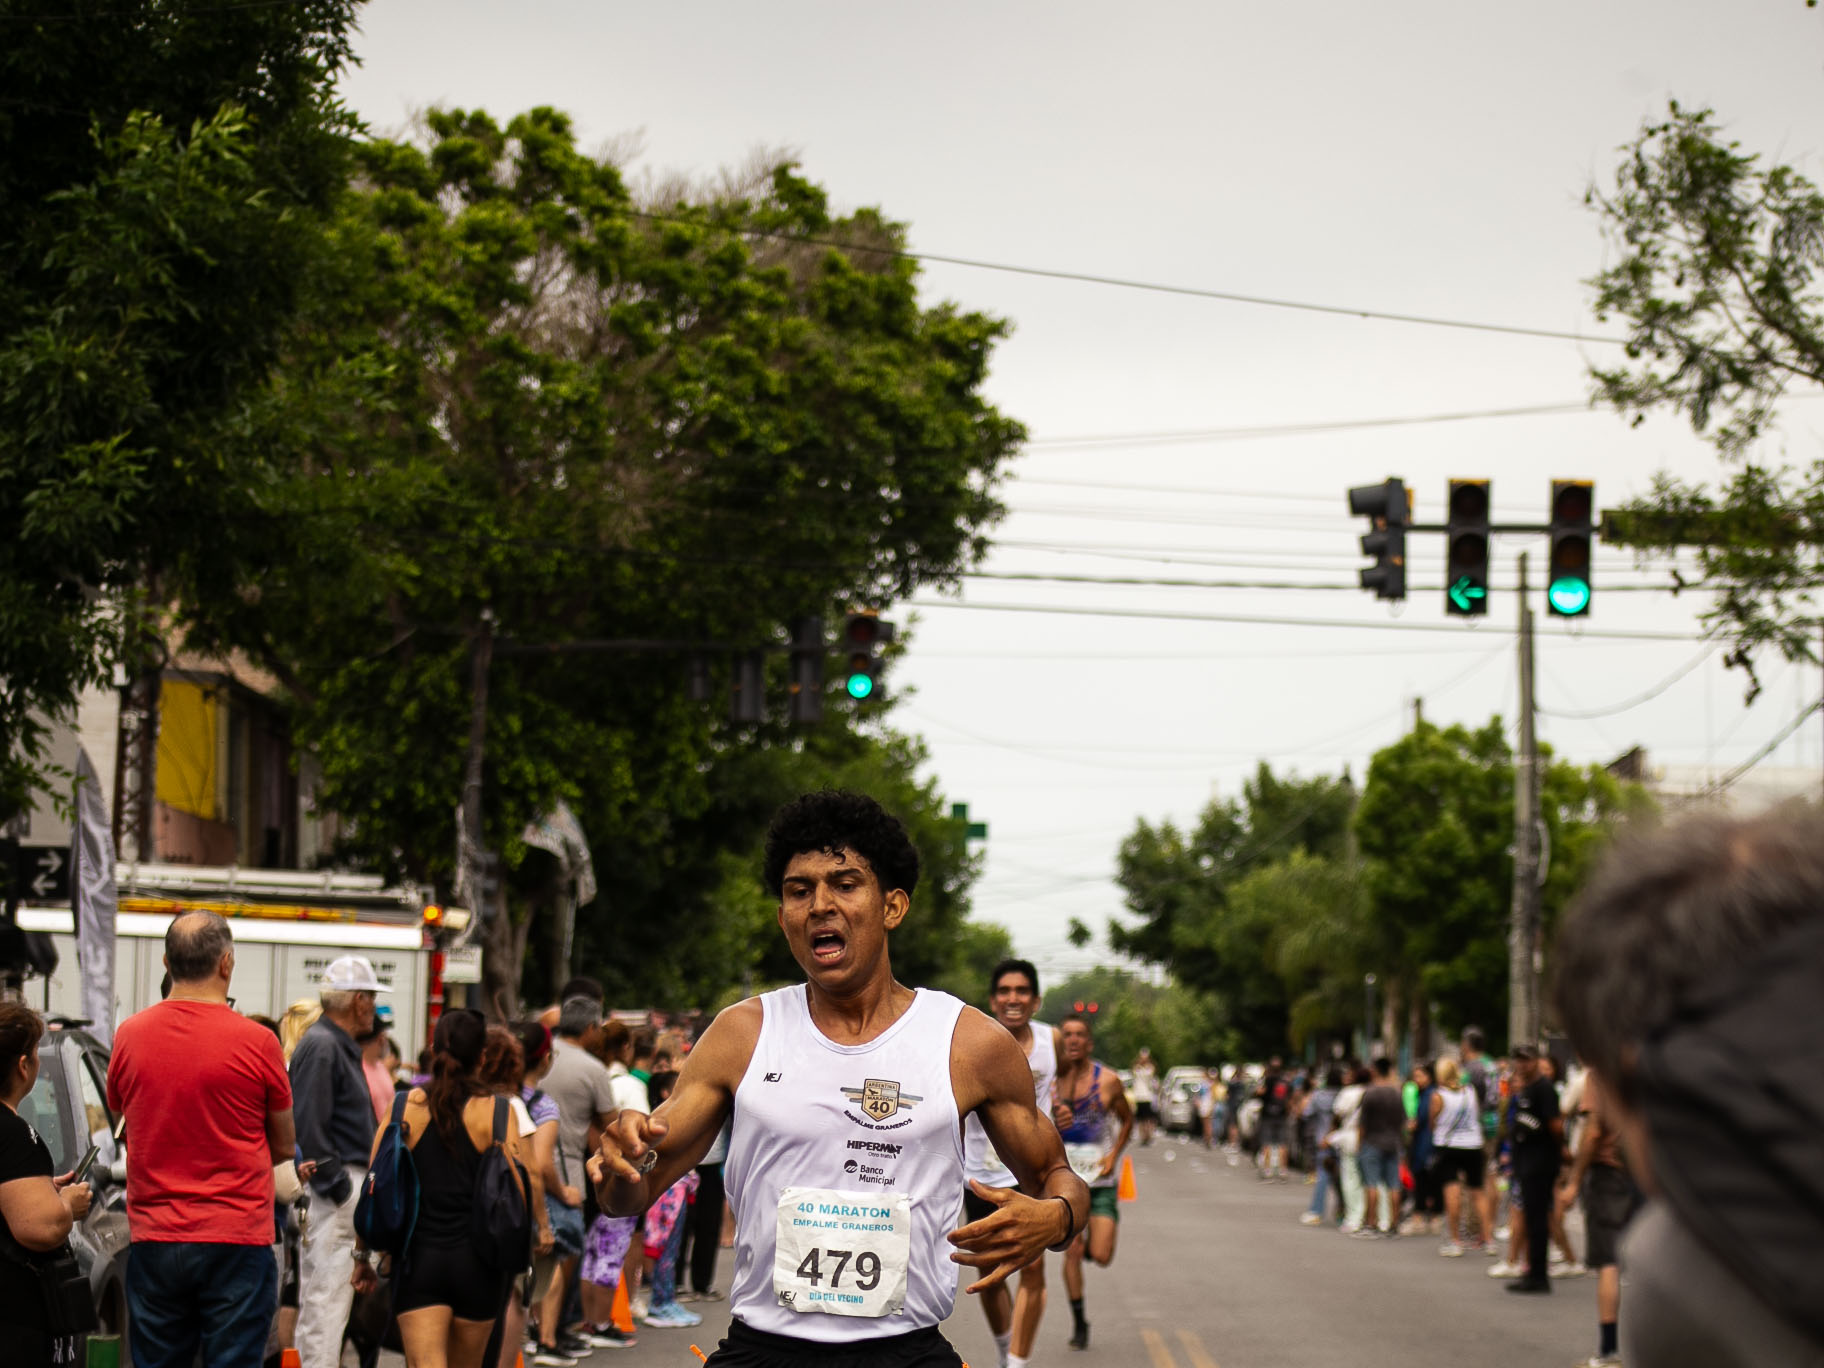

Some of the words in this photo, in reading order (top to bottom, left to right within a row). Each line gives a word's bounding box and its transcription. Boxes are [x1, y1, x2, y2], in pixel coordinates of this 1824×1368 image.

[869, 1101, 890, 1114] 40
[843, 1109, 875, 1130] EMPALME
[874, 1118, 913, 1131] GRANEROS
[860, 1164, 884, 1175] Banco
[858, 1173, 896, 1187] Municipal
[797, 1202, 815, 1214] 40
[819, 1204, 891, 1218] MARATON
[793, 1218, 839, 1229] EMPALME
[841, 1222, 894, 1232] GRANEROS
[796, 1247, 882, 1291] 479
[823, 1292, 836, 1301] DEL
[837, 1294, 864, 1304] VECINO
